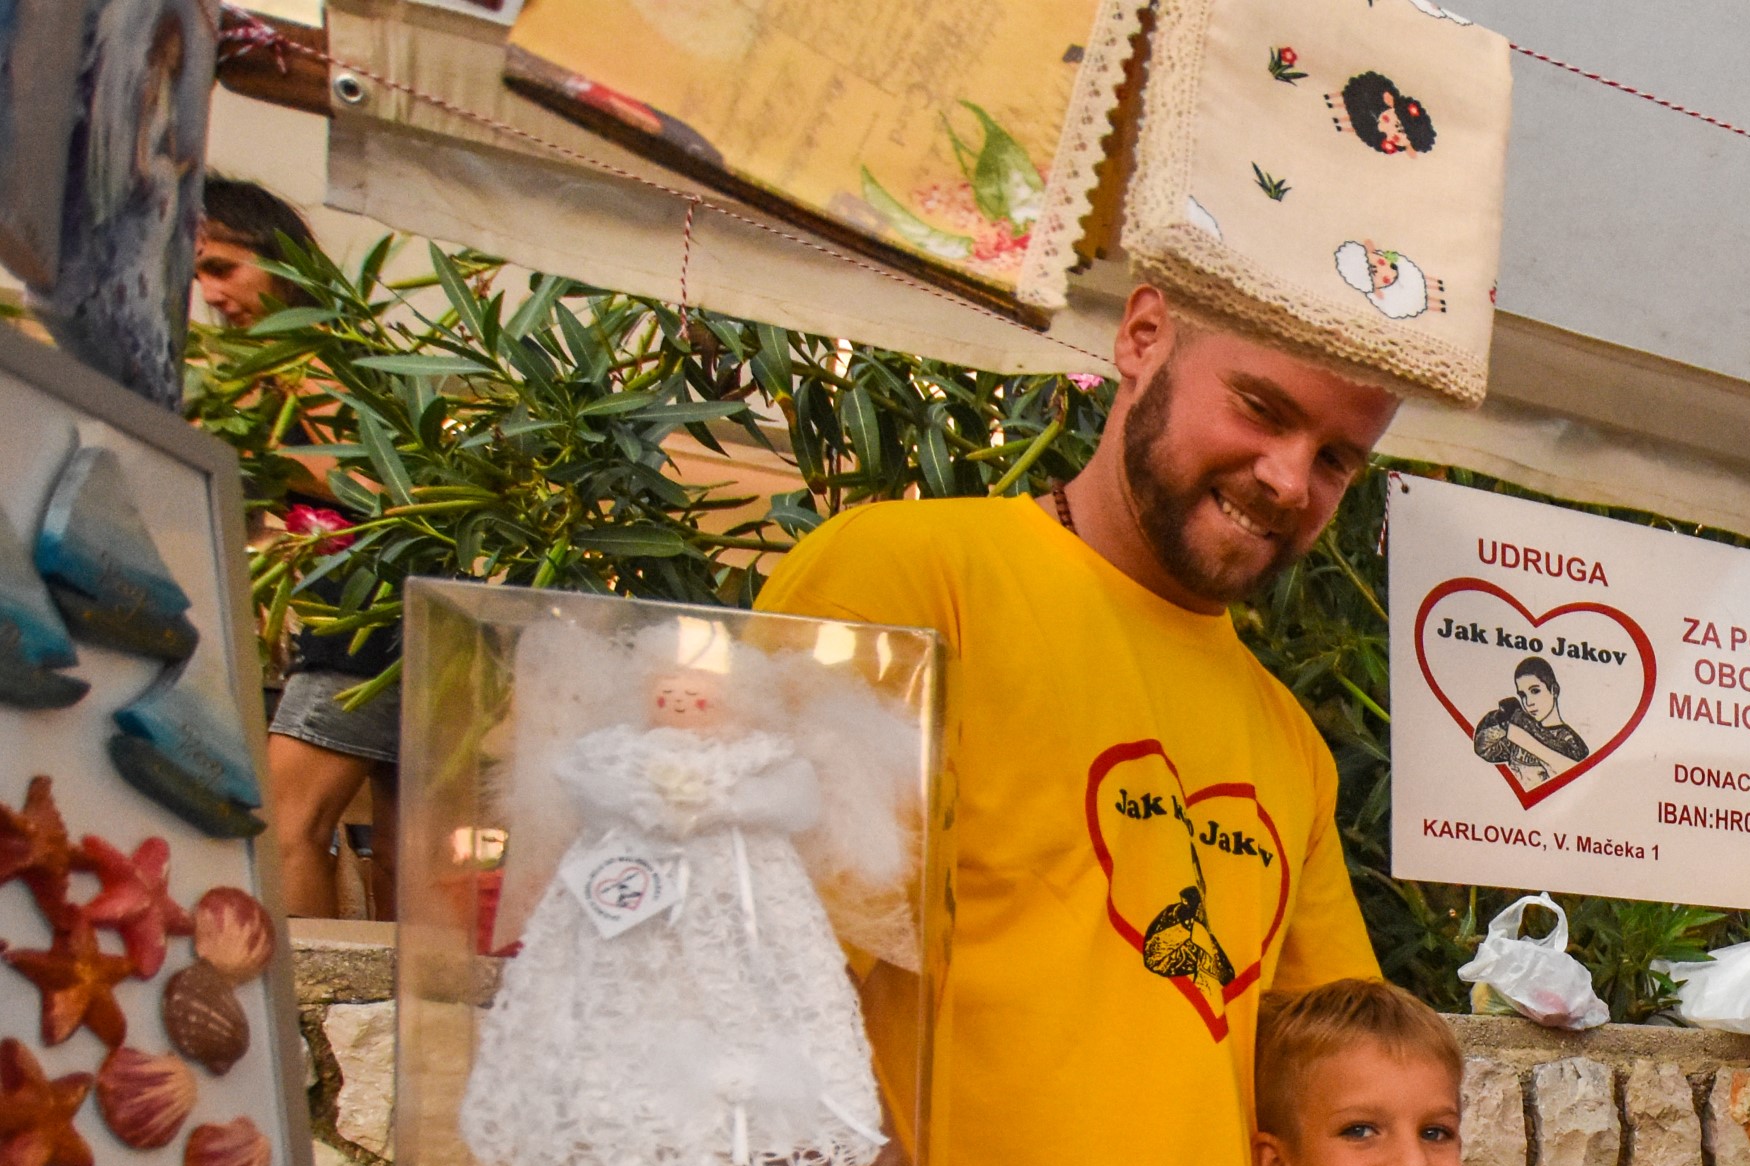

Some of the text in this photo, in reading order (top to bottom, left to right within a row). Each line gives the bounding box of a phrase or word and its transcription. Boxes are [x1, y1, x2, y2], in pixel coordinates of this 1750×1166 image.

[1478, 539, 1609, 587] UDRUGA
[1438, 617, 1628, 666] Jak kao Jakov
[1683, 617, 1722, 649] ZA
[1115, 789, 1167, 819] Jak
[1423, 818, 1661, 861] KARLOVAC, V. Mačeka 1
